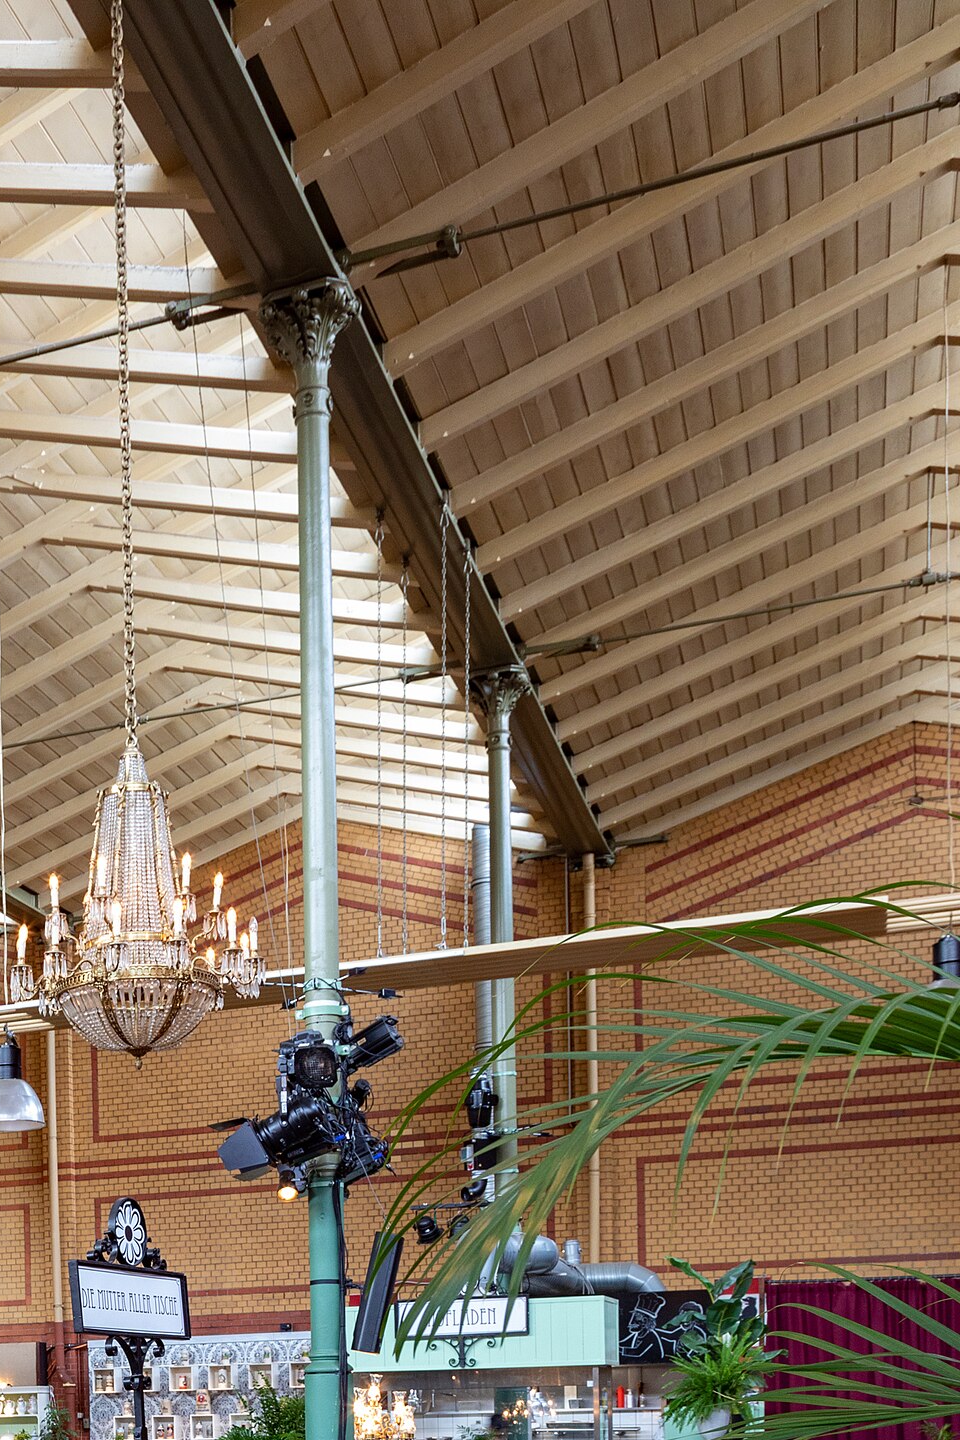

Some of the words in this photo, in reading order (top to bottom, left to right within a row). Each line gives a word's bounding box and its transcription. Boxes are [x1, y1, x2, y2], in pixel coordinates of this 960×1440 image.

[81, 1288, 96, 1308] DIE
[97, 1289, 127, 1312] MUTTER
[129, 1292, 152, 1314] ALLER
[153, 1295, 179, 1316] TISCHE
[428, 1307, 496, 1327] FLADEN
